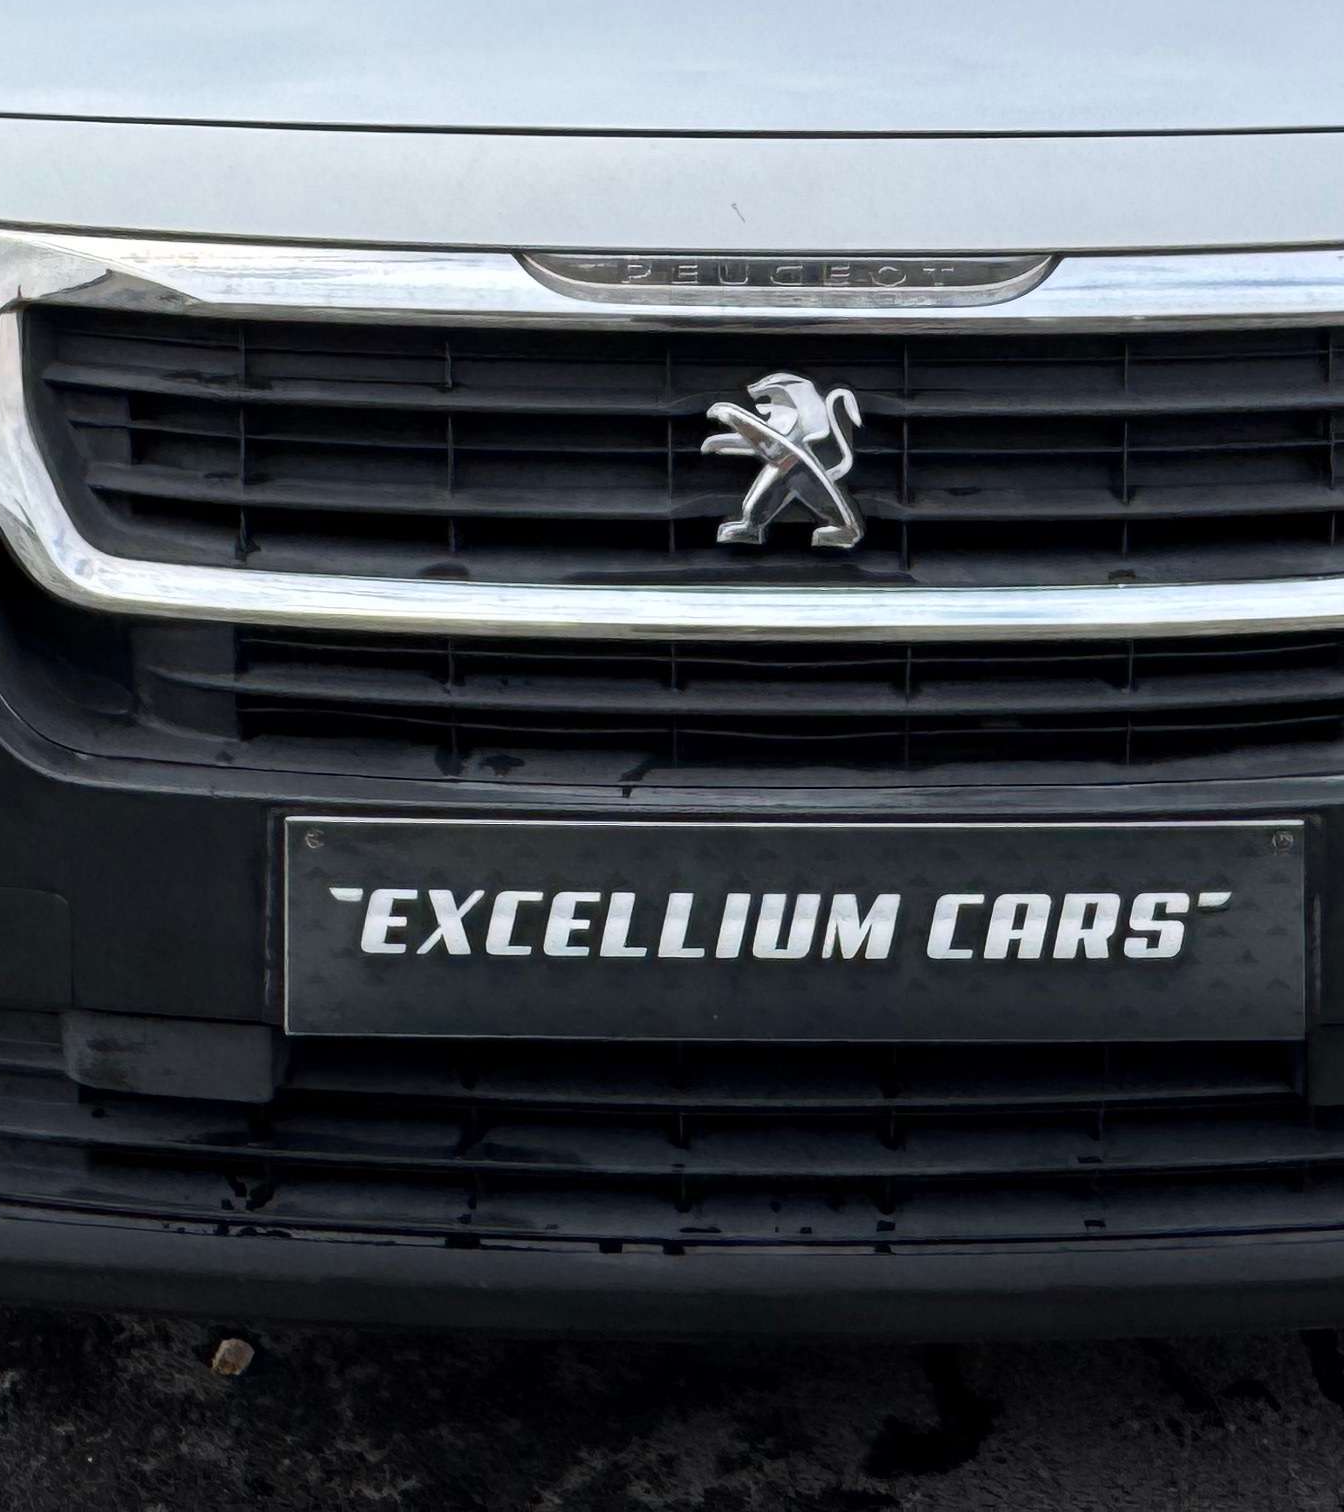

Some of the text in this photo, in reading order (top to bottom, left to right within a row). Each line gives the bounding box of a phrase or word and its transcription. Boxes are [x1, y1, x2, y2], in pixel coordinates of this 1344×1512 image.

[620, 260, 955, 287] PEUGEOT
[361, 888, 1190, 962] EXCELLIUM CARS
